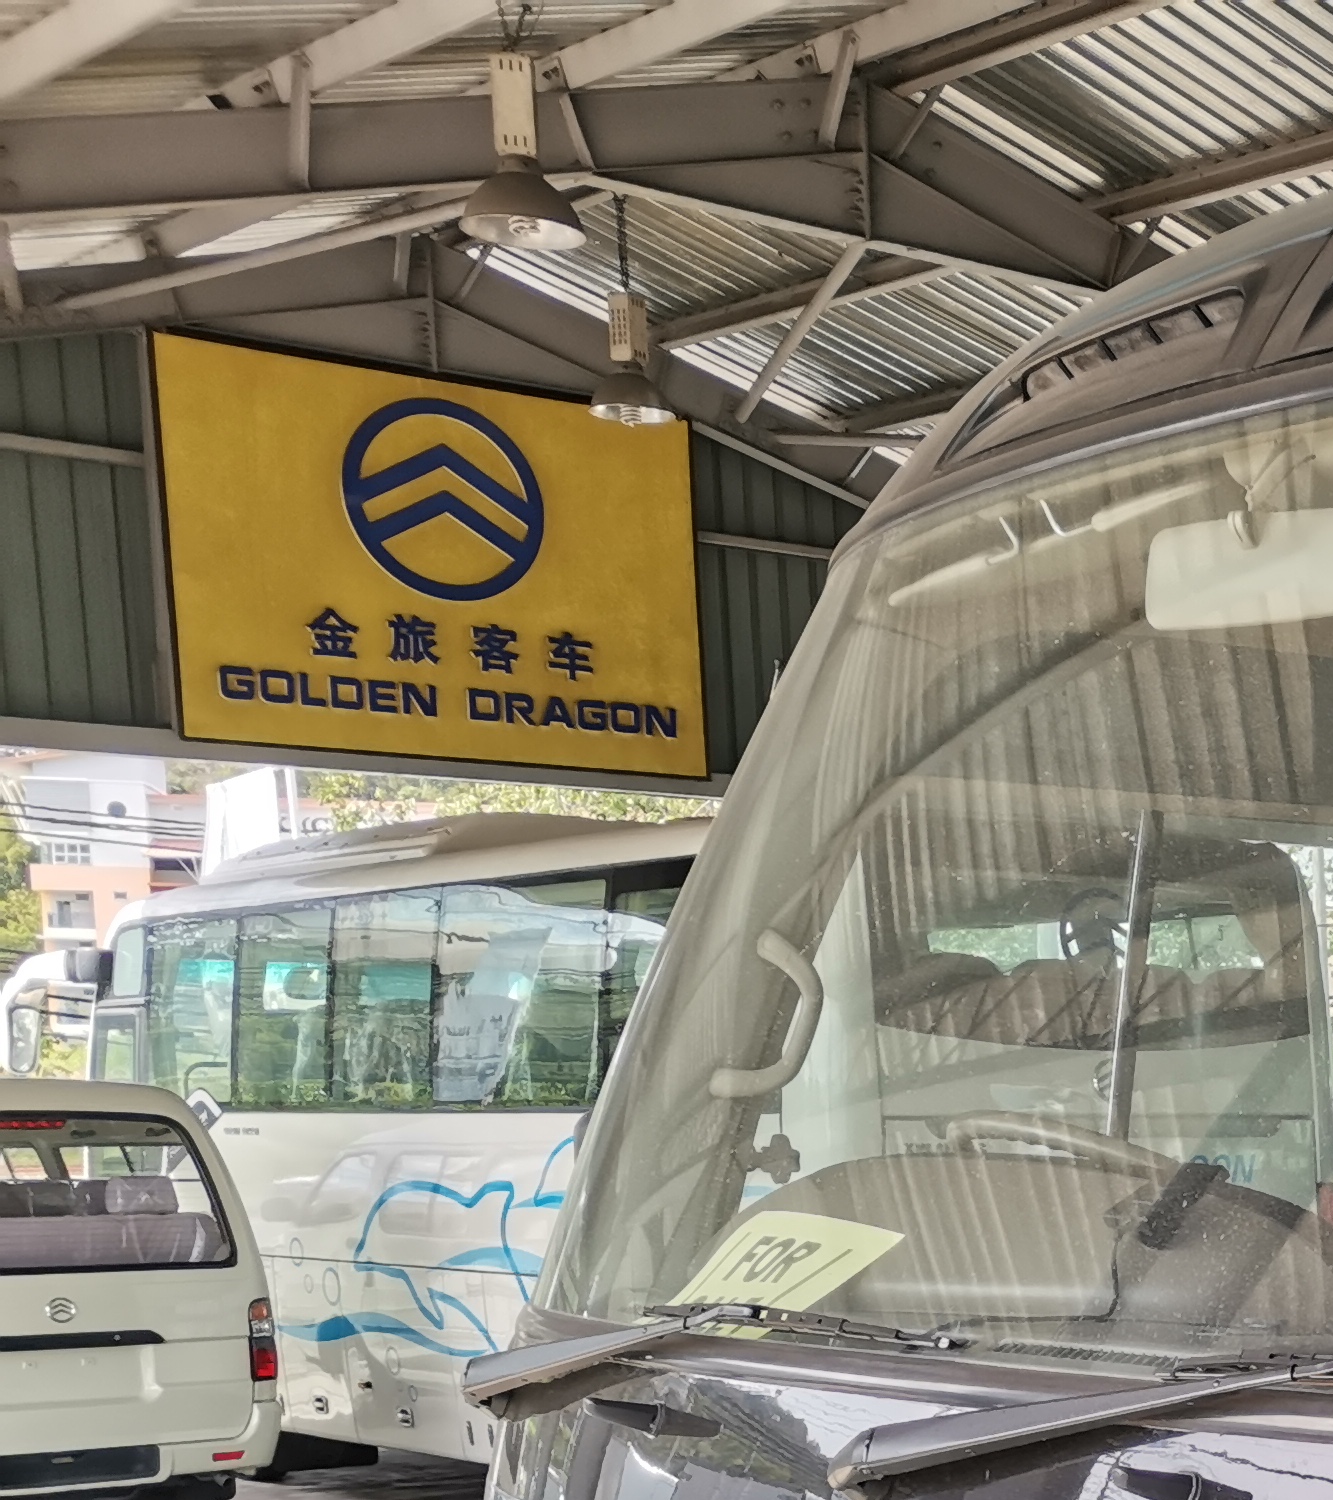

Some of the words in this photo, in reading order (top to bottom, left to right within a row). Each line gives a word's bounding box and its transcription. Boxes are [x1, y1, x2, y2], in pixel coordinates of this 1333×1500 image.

[305, 607, 594, 681] 金旅客车
[218, 665, 437, 718] GOLDEN
[467, 688, 678, 739] DRAGON
[721, 1235, 822, 1284] FOR
